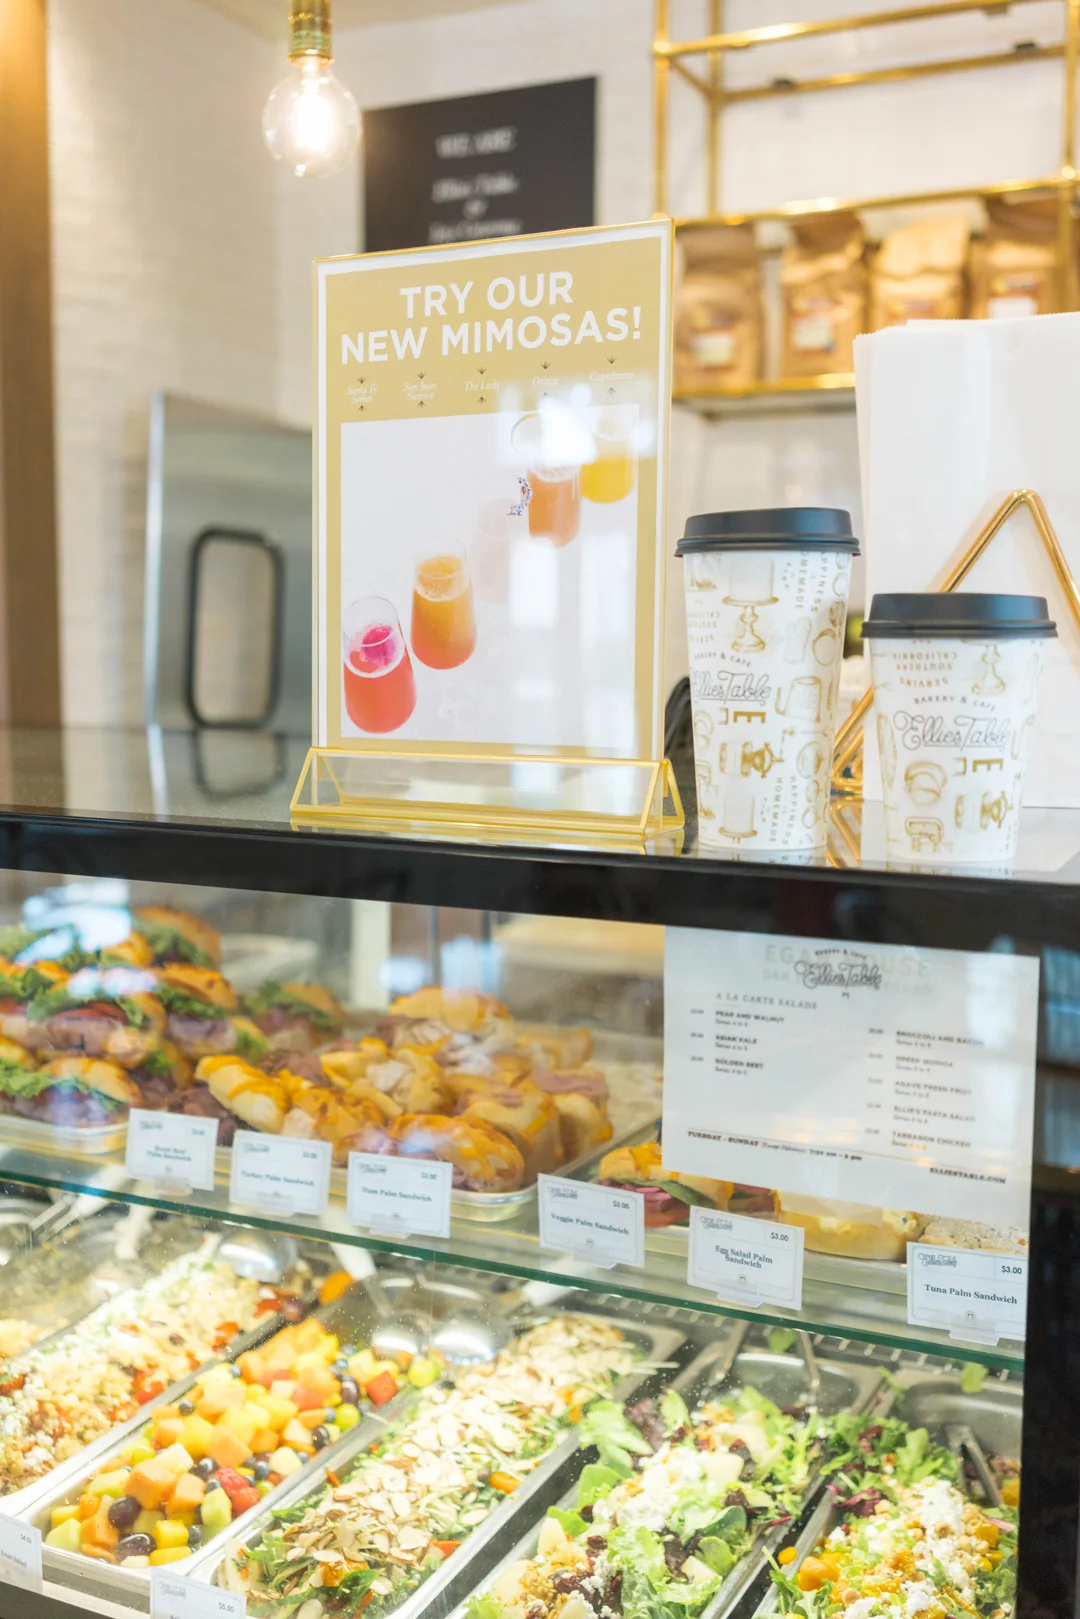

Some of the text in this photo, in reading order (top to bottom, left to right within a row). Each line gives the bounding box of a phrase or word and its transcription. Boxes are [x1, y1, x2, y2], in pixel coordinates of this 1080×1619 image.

[400, 271, 574, 319] TRY OUR
[341, 305, 642, 364] NEW MIMOSAS!
[464, 380, 479, 392] The
[914, 695, 956, 706] BAKERY
[960, 695, 968, 705] &
[769, 776, 784, 842] HOMEMADE
[715, 991, 819, 1011] A LA CARTE SALADS
[687, 1130, 721, 1143] TUESDAY
[728, 1136, 759, 1149] SUNDAY
[282, 1176, 316, 1188] Sandwich
[929, 1166, 1006, 1185] ELLIESTABLE.COM
[380, 1188, 398, 1198] Palm
[398, 1191, 433, 1203] Sandwich
[612, 1199, 630, 1211] $3.00
[550, 1212, 630, 1237] Veggie Palm Sandwich
[770, 1231, 789, 1242] $3.00
[715, 1244, 774, 1265] Egg Salad Palm
[725, 1253, 762, 1270] Sandwich
[1001, 1264, 1023, 1276] $3.00
[924, 1283, 1018, 1305] Tuna Palm Sandwich
